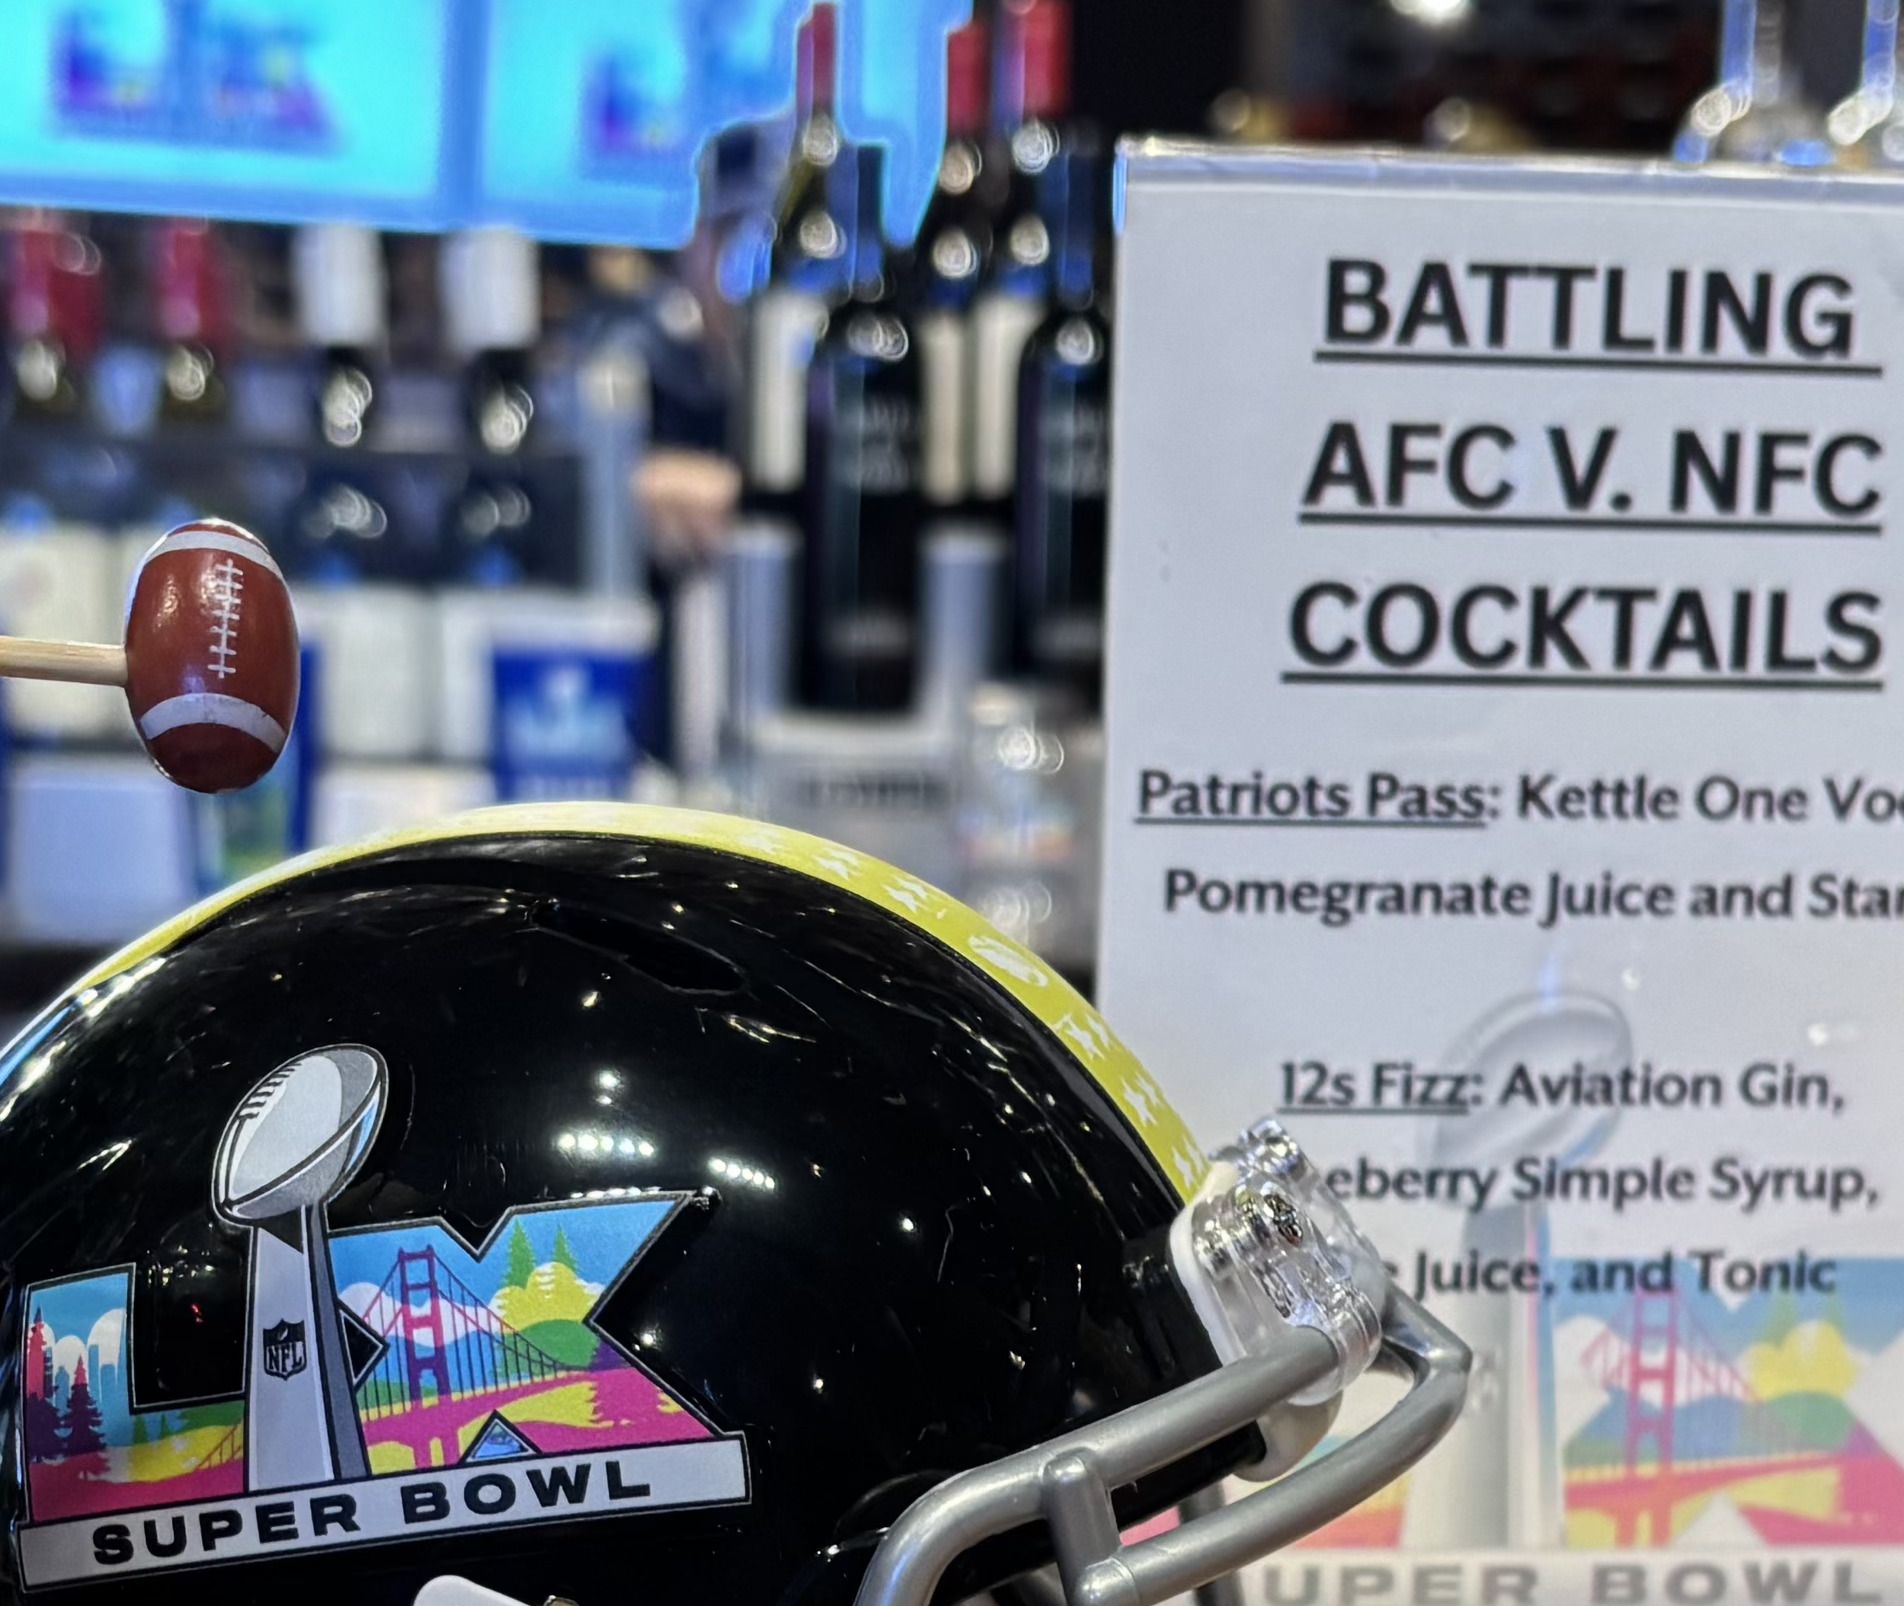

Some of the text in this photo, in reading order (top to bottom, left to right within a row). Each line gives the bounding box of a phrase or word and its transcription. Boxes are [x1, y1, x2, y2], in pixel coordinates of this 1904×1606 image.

[1325, 257, 1855, 358] BATTLING
[1301, 421, 1883, 517] AFC V. NFC
[1287, 580, 1883, 675] COCKTAILS
[1138, 769, 1351, 818] Patriots
[1366, 771, 1500, 821] Pass:
[1517, 773, 1679, 821] Kettle
[1694, 774, 1809, 822] One
[1164, 868, 1532, 928] Pomegranate
[1544, 871, 1676, 931] Juice
[1689, 872, 1794, 918] and
[1282, 1060, 1846, 1114] 12s Fizz: Aviation Gin,
[1325, 1155, 1880, 1214] eberry Simple Syrup,
[1414, 1250, 1556, 1301] Juice,
[1569, 1251, 1676, 1296] and
[1693, 1250, 1839, 1296] Tonic
[92, 1460, 652, 1566] SUPER BOWL
[1590, 1560, 1884, 1606] BOWL
